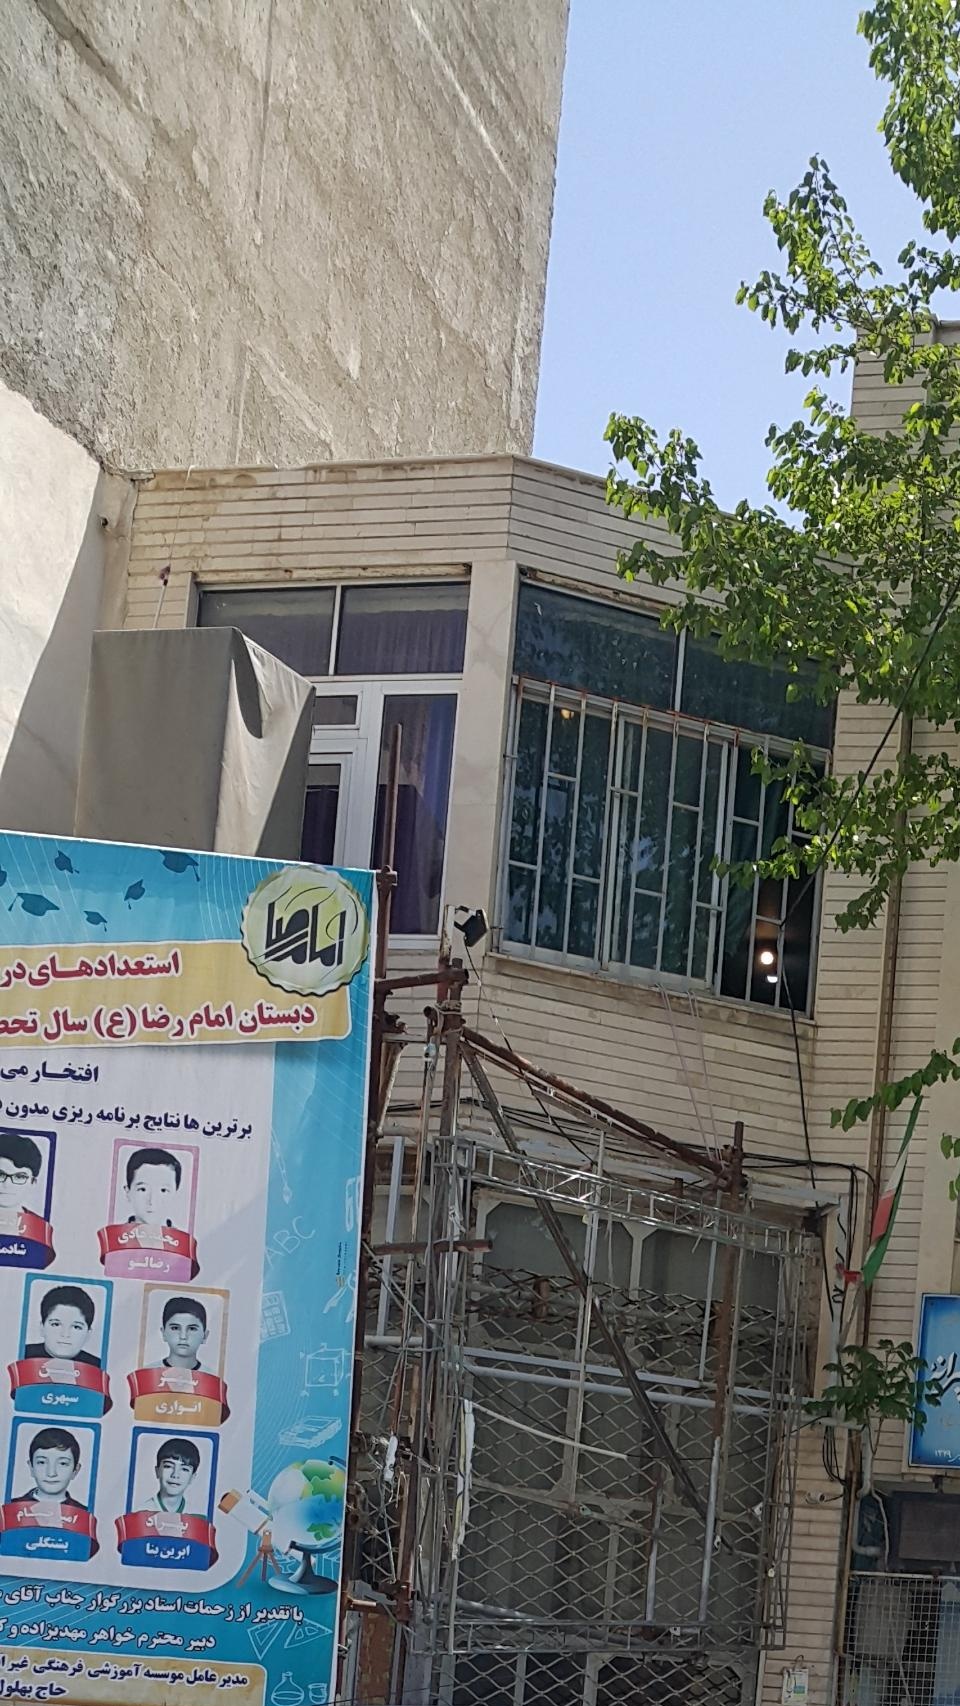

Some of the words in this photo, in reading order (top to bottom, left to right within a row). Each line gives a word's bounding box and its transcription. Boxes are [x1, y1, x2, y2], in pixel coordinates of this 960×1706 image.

[28, 951, 180, 985] استعدادهای
[43, 1009, 88, 1040] سال
[94, 1007, 138, 1039] (ع)
[143, 1005, 184, 1038] رضا
[190, 1004, 233, 1035] امام
[239, 1002, 315, 1033] دبستان
[1, 1065, 28, 1080] می
[30, 1061, 99, 1083] افتخار
[5, 1101, 50, 1119] مدون
[52, 1105, 93, 1125] ریزی
[97, 1106, 141, 1129] برنامه
[143, 1112, 181, 1131] نتایج
[184, 1112, 200, 1130] ها
[202, 1118, 253, 1139] برترین
[41, 1392, 79, 1407] سپهری
[155, 1400, 202, 1416] انواری
[5, 1585, 45, 1605] آقای
[45, 1588, 86, 1609] جناب
[87, 1591, 143, 1614] بزرگوار
[144, 1597, 182, 1614] استاد
[184, 1598, 235, 1621] زحمات
[236, 1604, 251, 1622] از
[252, 1605, 291, 1624] تقدیر
[292, 1604, 304, 1627] با
[20, 1620, 88, 1642] مهدیزاده
[88, 1626, 135, 1646] خواهر
[137, 1631, 184, 1649] محترم
[186, 1631, 216, 1651] دبیر
[7, 1656, 29, 1672] غیر
[32, 1658, 84, 1677] فرهنگی
[87, 1663, 141, 1681] آموزشی
[143, 1669, 184, 1684] موسسه
[186, 1669, 217, 1685] عامل
[219, 1674, 248, 1688] مدیر
[35, 1682, 67, 1700] حاج
